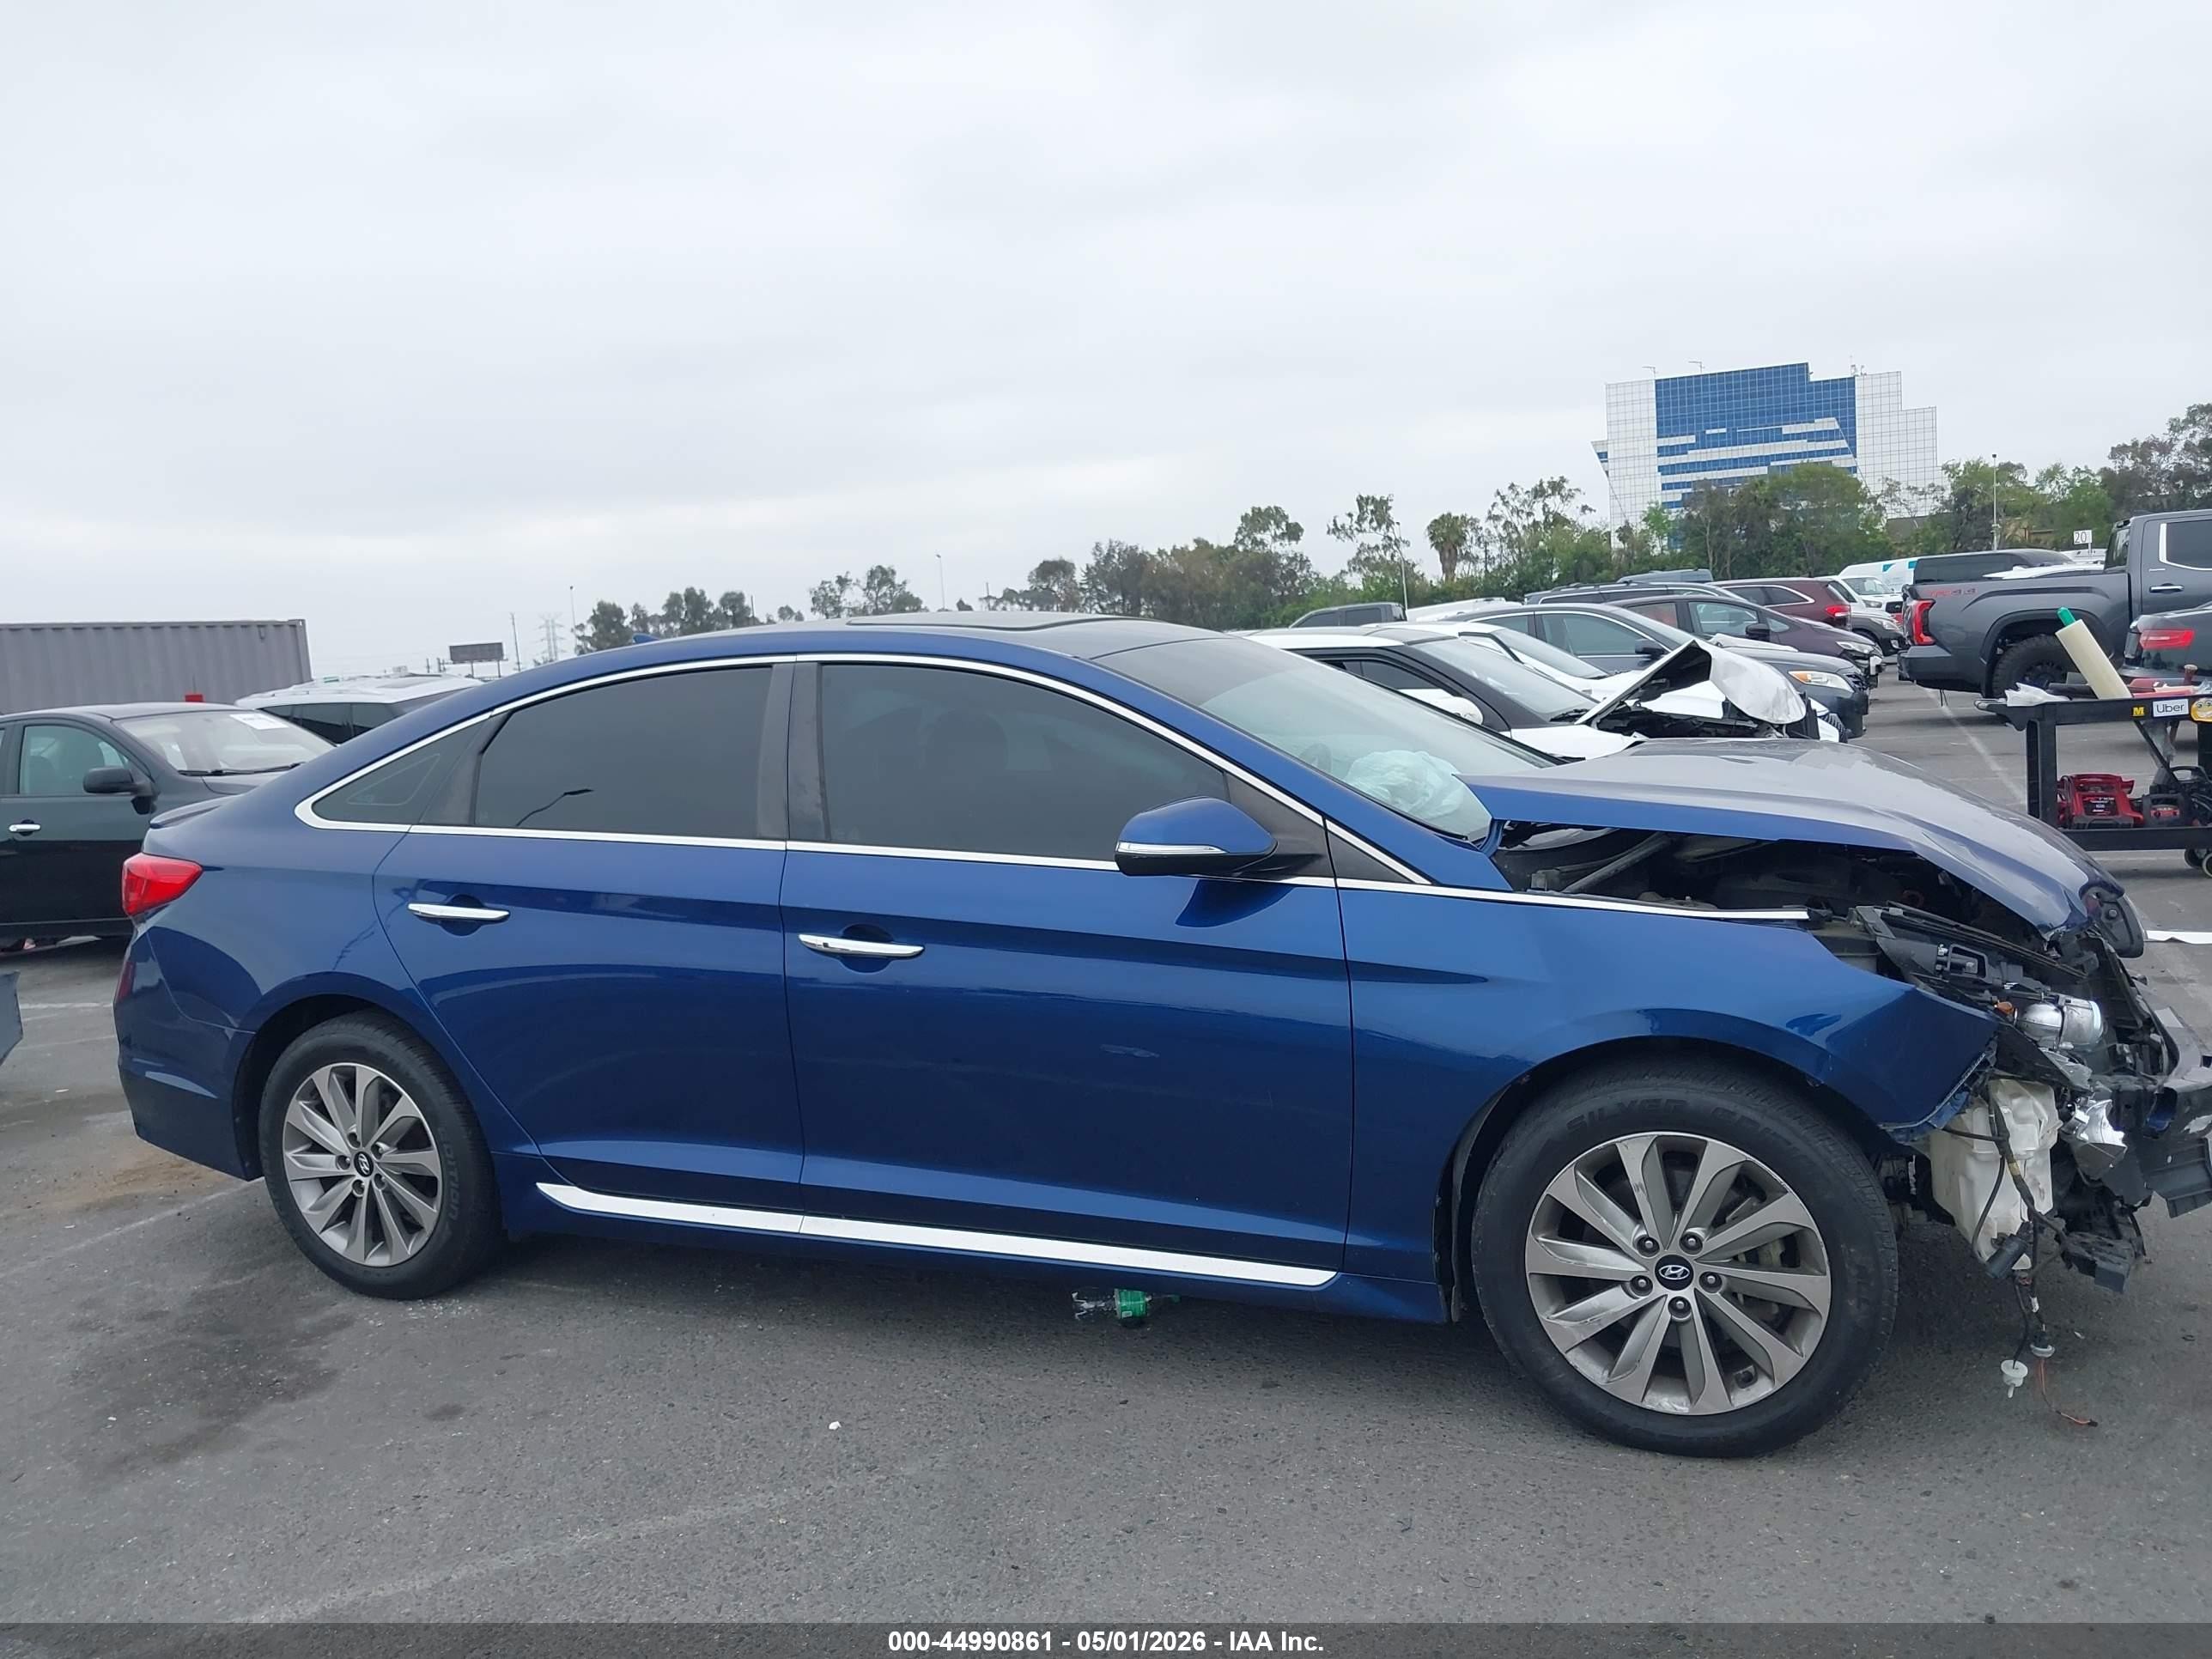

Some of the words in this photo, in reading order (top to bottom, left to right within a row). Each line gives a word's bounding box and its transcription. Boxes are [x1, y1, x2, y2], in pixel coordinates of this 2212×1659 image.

[2074, 531, 2087, 543] 20
[2132, 707, 2145, 717] M
[2156, 703, 2185, 714] Uber
